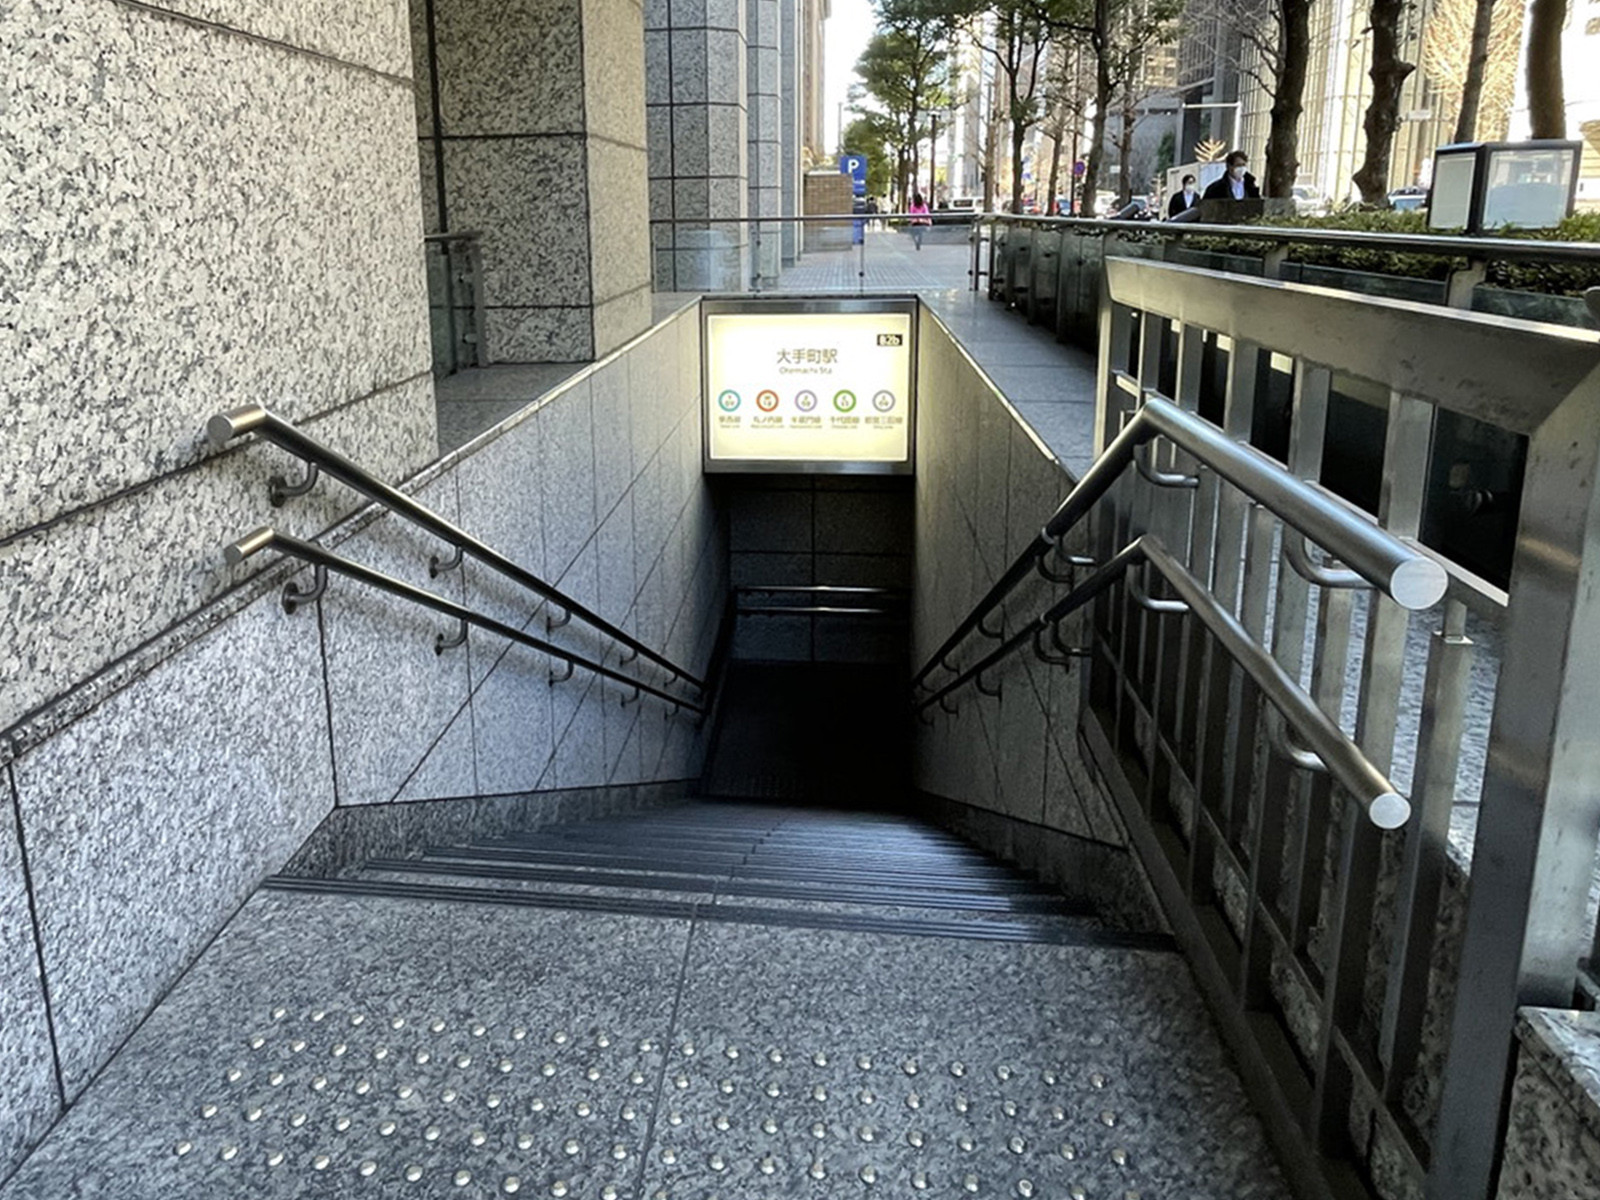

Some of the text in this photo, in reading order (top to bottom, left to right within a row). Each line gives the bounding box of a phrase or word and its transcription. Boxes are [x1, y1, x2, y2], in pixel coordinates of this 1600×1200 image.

[848, 159, 860, 174] P
[777, 348, 838, 364] 大手町駅
